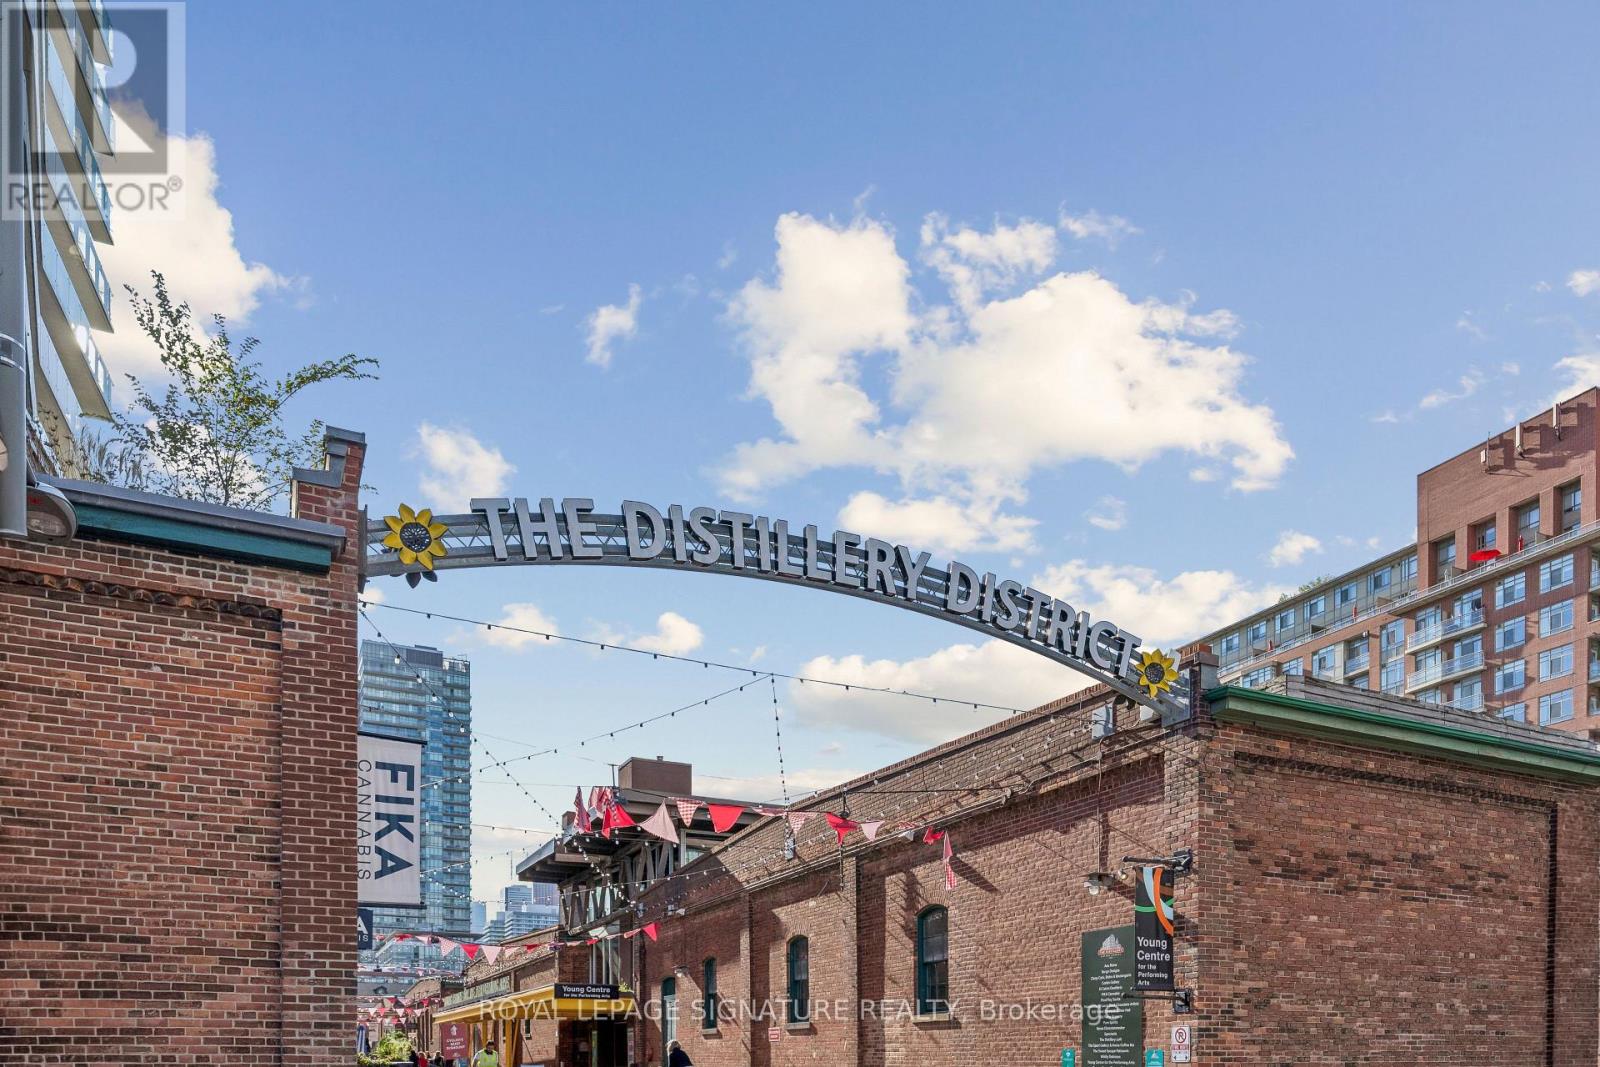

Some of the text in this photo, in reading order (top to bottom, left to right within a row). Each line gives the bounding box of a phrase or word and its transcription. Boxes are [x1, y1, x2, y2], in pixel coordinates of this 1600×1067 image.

[470, 497, 1143, 680] THE DISTILLERY DISTRICT
[357, 759, 372, 880] CANNABIS
[374, 760, 415, 880] FIKA
[1137, 936, 1168, 950] Young
[1137, 950, 1171, 961] Centre
[562, 985, 611, 993] Young Centre
